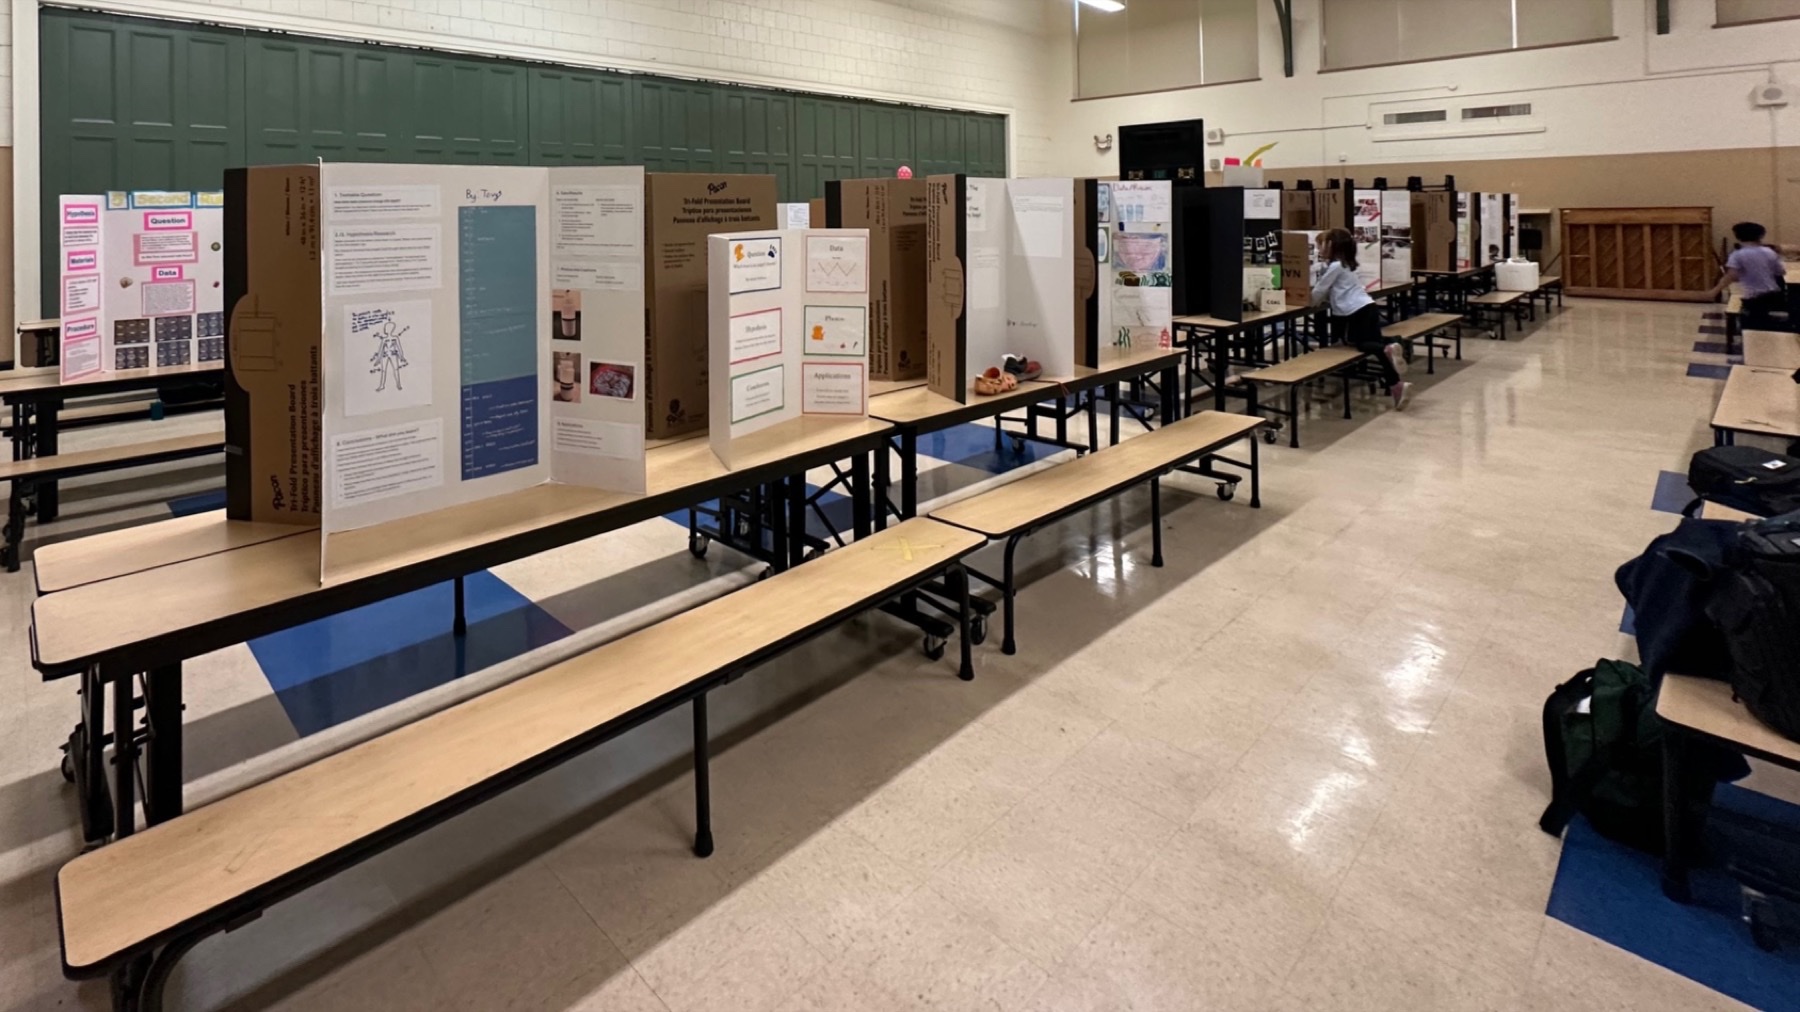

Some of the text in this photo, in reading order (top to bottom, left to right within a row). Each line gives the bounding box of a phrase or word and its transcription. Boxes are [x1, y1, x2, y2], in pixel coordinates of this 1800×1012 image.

[112, 192, 123, 206] 5
[150, 217, 186, 225] Question
[71, 256, 94, 264] Materials
[747, 249, 766, 259] Question
[66, 323, 95, 332] Procedure
[309, 346, 318, 384] battants
[813, 372, 851, 381] Applications
[310, 387, 319, 407] trois
[300, 380, 310, 451] presentaciones
[288, 384, 298, 512] Tri-Fold Presentation Board
[311, 421, 321, 470] d'affichage
[301, 453, 310, 475] para
[270, 474, 286, 511] Pacon
[312, 473, 320, 513] Panneau
